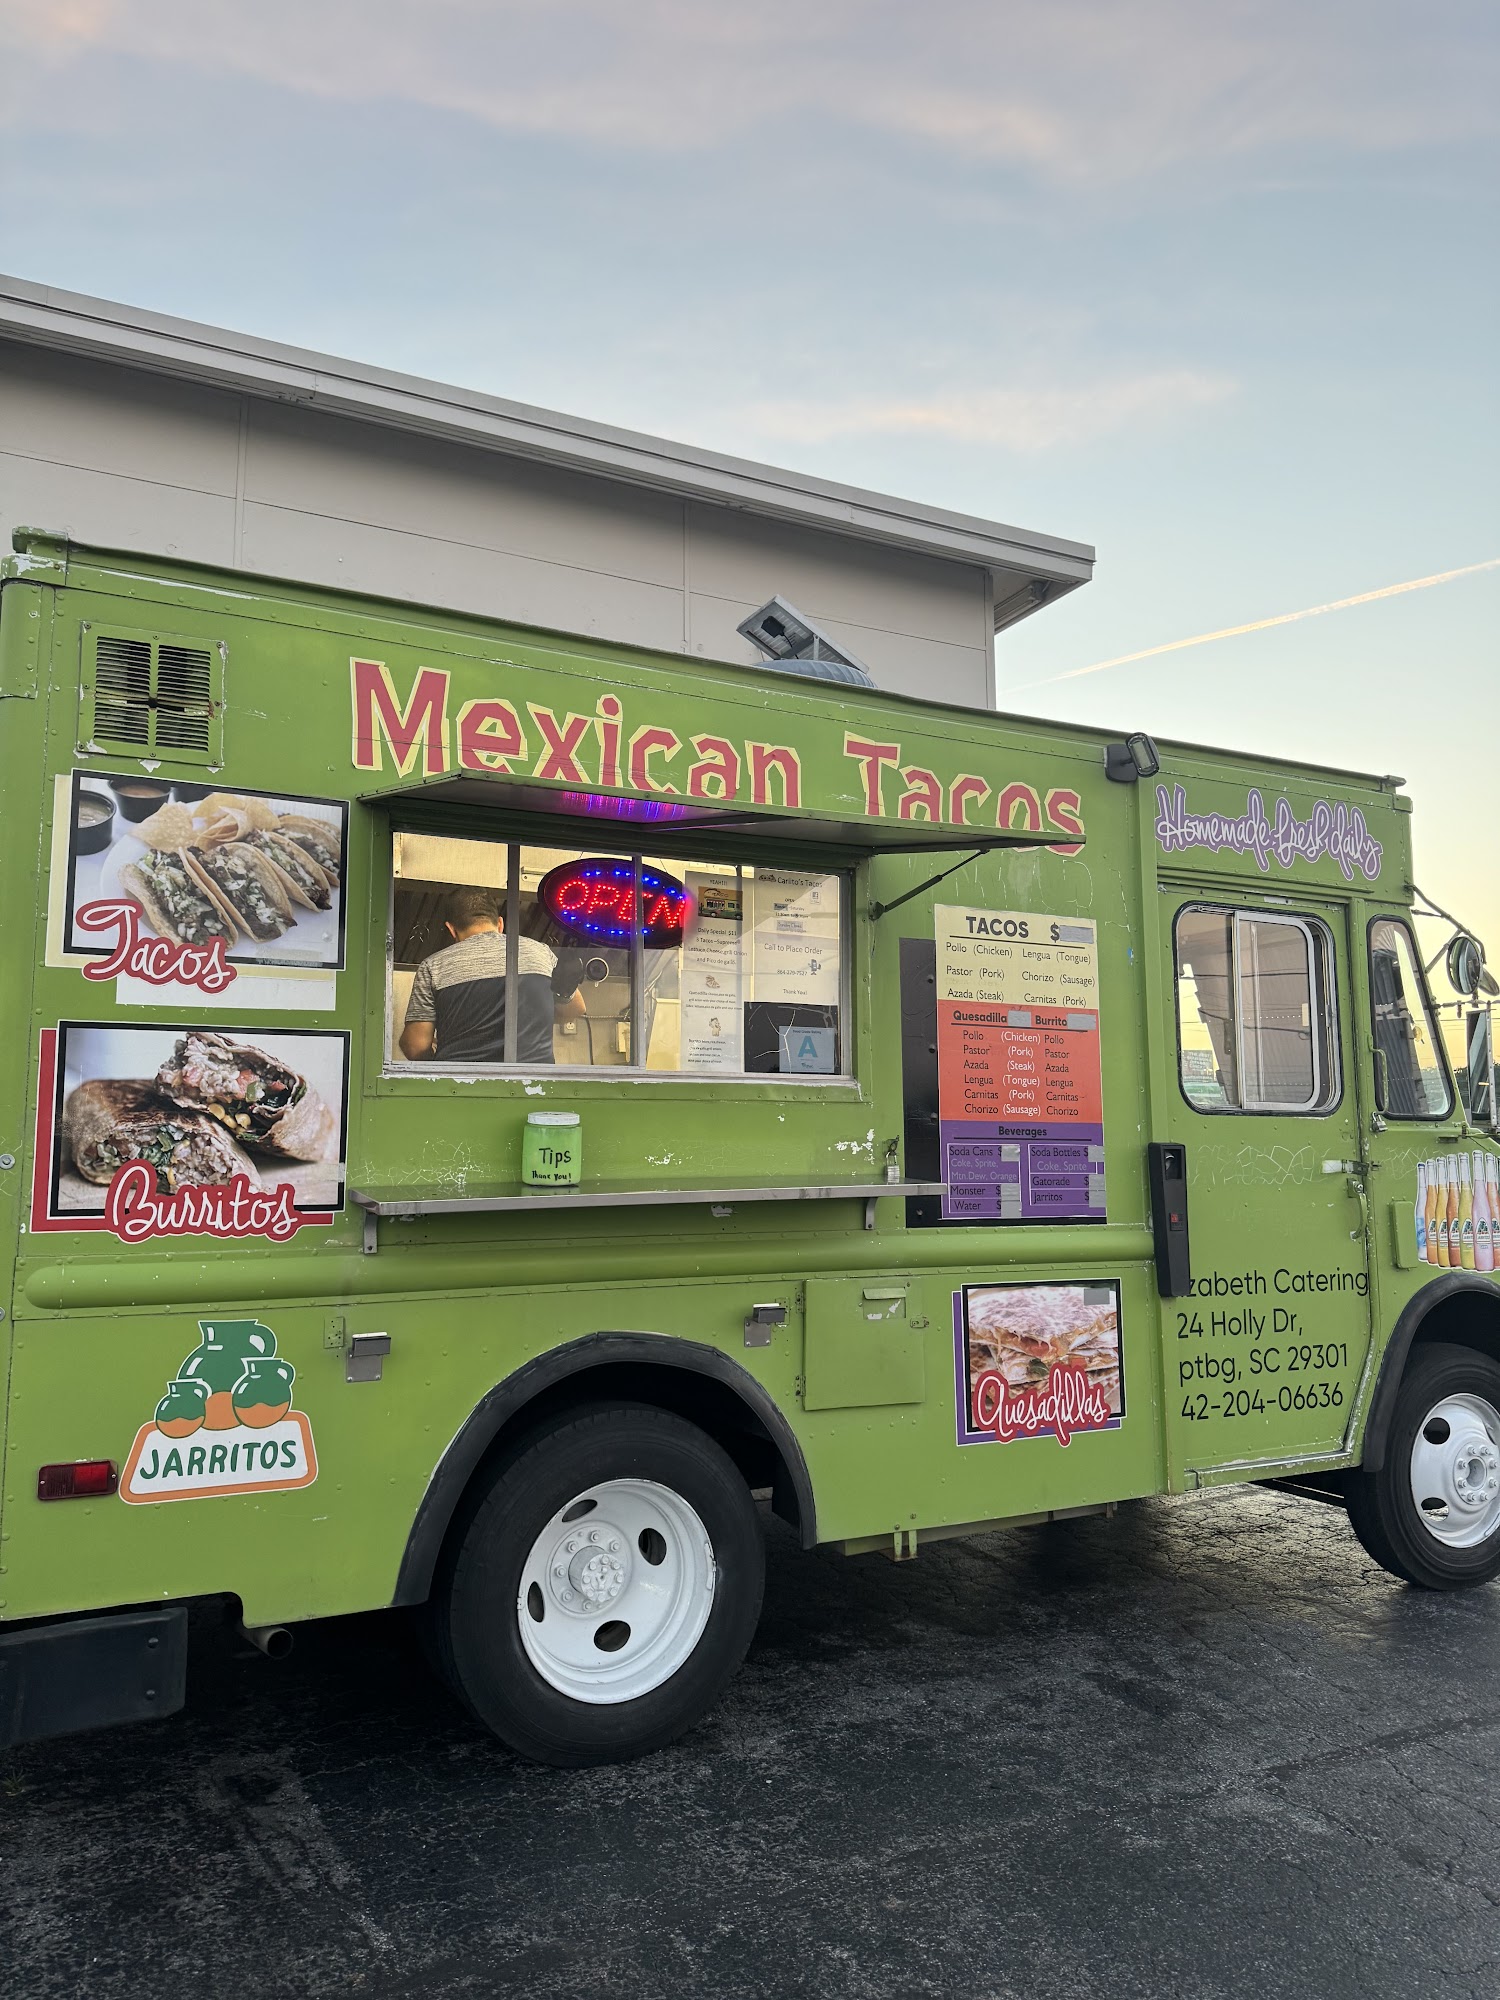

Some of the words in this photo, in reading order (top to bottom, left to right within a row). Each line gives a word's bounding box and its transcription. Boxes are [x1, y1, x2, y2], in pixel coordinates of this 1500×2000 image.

[350, 656, 802, 808] Mexican
[843, 730, 1085, 856] Tacos
[1156, 785, 1270, 870] Homemade
[1331, 802, 1382, 879] daily
[557, 879, 686, 929] OPEN
[965, 916, 1029, 939] TACOS
[82, 903, 232, 989] Tacos
[804, 946, 823, 955] Order
[946, 942, 967, 953] Pollo
[973, 944, 1013, 959] (Chicken)
[1022, 951, 1051, 962] Lengua
[1056, 951, 1091, 965] (Tongue)
[946, 965, 973, 976] Pastor
[979, 967, 1005, 981] (Pork)
[1021, 971, 1054, 983] Chorizo
[1059, 974, 1095, 987] (Sausage)
[947, 988, 973, 999] Azada
[976, 989, 1005, 1002] (Steak)
[1023, 993, 1057, 1004] Carnitas
[1062, 995, 1087, 1008] (Pork)
[953, 1010, 1008, 1024] Quesadilla
[1035, 1014, 1068, 1027] Burrito
[963, 1030, 984, 1041] Pollo
[1001, 1031, 1041, 1044] (Chicken)
[1044, 1034, 1065, 1044] Pollo
[797, 1035, 818, 1058] A
[963, 1044, 990, 1055] Pastor
[1007, 1045, 1034, 1058] (Pork)
[1044, 1049, 1070, 1059] Pastor
[963, 1060, 989, 1070] Azada
[1007, 1060, 1035, 1073] (Steak)
[1044, 1063, 1069, 1073] Azada
[964, 1074, 994, 1087] Lengua
[1002, 1074, 1041, 1088] (Tongue)
[1045, 1077, 1074, 1089] Lengua
[964, 1089, 999, 1099] Carnitas
[1008, 1089, 1035, 1101] (Pork)
[1045, 1091, 1079, 1102] Carnitas
[964, 1103, 999, 1114] Chorizo
[1002, 1103, 1041, 1117] (Sausage)
[1046, 1105, 1079, 1116] Chorizo
[998, 1126, 1048, 1138] Beverages
[538, 1147, 572, 1169] Tips
[949, 1145, 970, 1156] Soda
[972, 1146, 993, 1157] Cans
[1031, 1147, 1051, 1157] Soda
[1053, 1147, 1081, 1157] Bottles
[950, 1158, 973, 1169] Coke,
[975, 1159, 999, 1171] Sprite,
[1036, 1161, 1061, 1172] Coke,
[1063, 1160, 1088, 1174] Sprite
[989, 1172, 1017, 1183] Orange
[1032, 1176, 1071, 1186] Gatorade
[950, 1185, 986, 1195] Monster
[1033, 1191, 1063, 1204] Jarritos
[111, 1164, 299, 1237] Burritos
[954, 1200, 981, 1211] Water
[1181, 1269, 1267, 1298] zabeth
[1273, 1267, 1369, 1297] Catering
[1177, 1312, 1204, 1339] 24
[1211, 1308, 1266, 1340] Holly
[1273, 1308, 1303, 1336] Dr,
[1179, 1352, 1242, 1387] ptbg,
[1250, 1347, 1281, 1375] SC
[1287, 1343, 1348, 1372] 29301
[977, 1367, 1108, 1441] Quesadillas
[1181, 1382, 1344, 1421] 42-204-06636
[139, 1440, 297, 1480] JARRITOS
